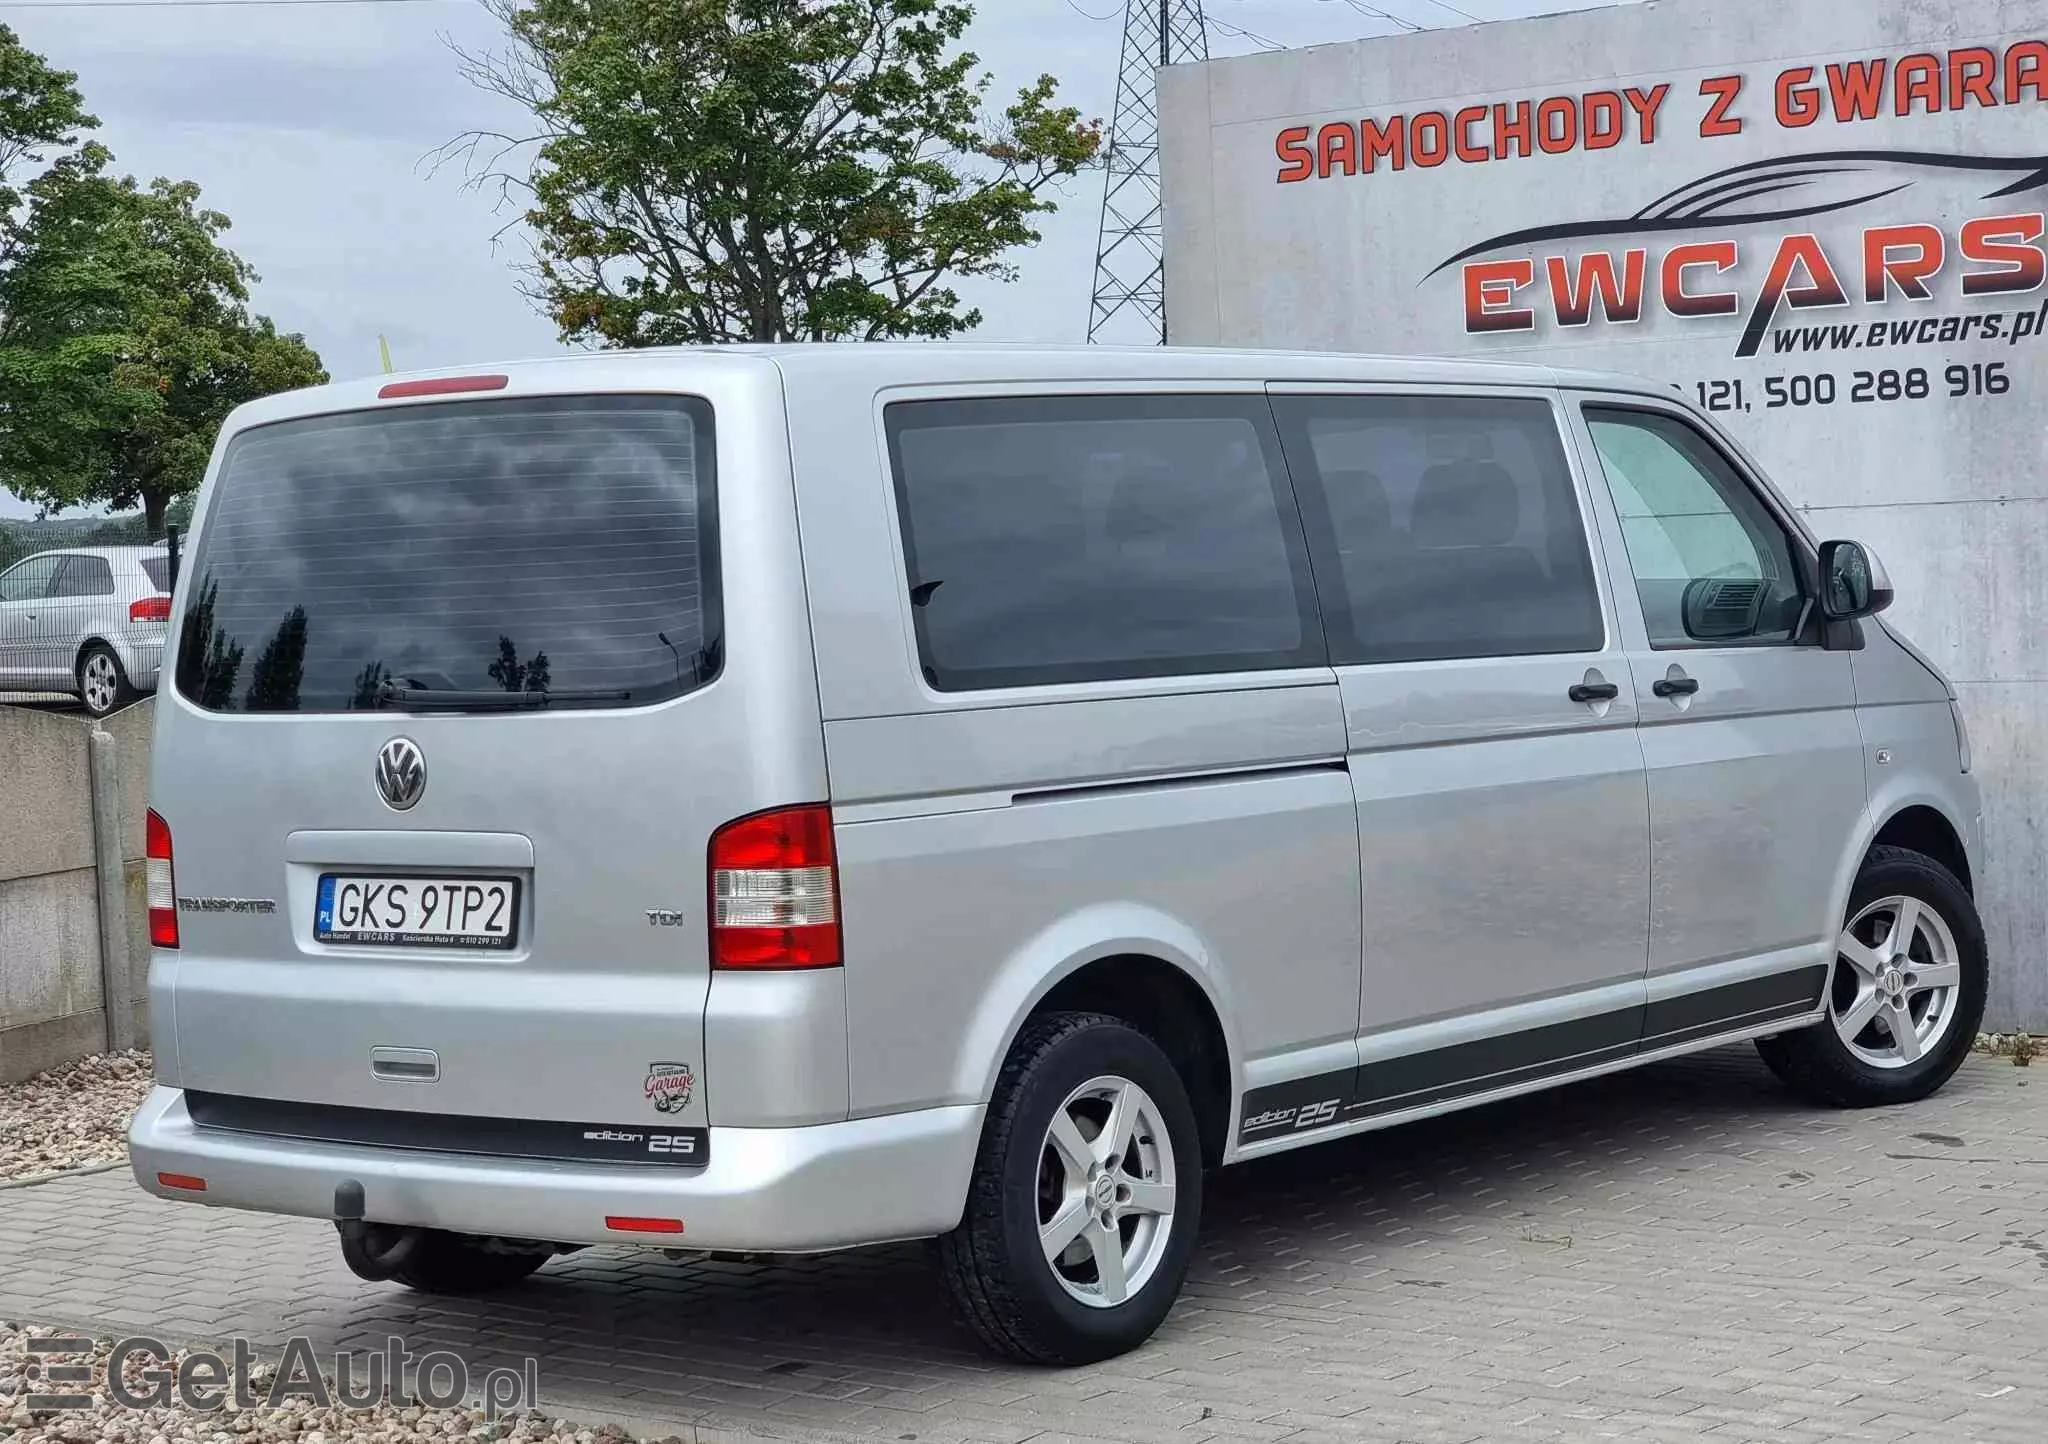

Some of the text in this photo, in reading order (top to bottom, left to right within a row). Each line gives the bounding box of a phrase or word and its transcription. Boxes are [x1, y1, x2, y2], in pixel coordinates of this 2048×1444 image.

[1277, 40, 2048, 184] SAMOCHODY Z GWARA
[1464, 212, 2047, 358] EWCARS
[1774, 302, 2048, 353] www.ewcars.pl
[1697, 362, 2011, 414] 121, 500 288 916
[320, 911, 331, 923] PL
[339, 883, 506, 932] GKS 9TP2
[357, 931, 396, 942] EWCARS
[644, 1074, 695, 1098] Garage
[1295, 1099, 1341, 1128] 25
[583, 1130, 696, 1153] edition 25
